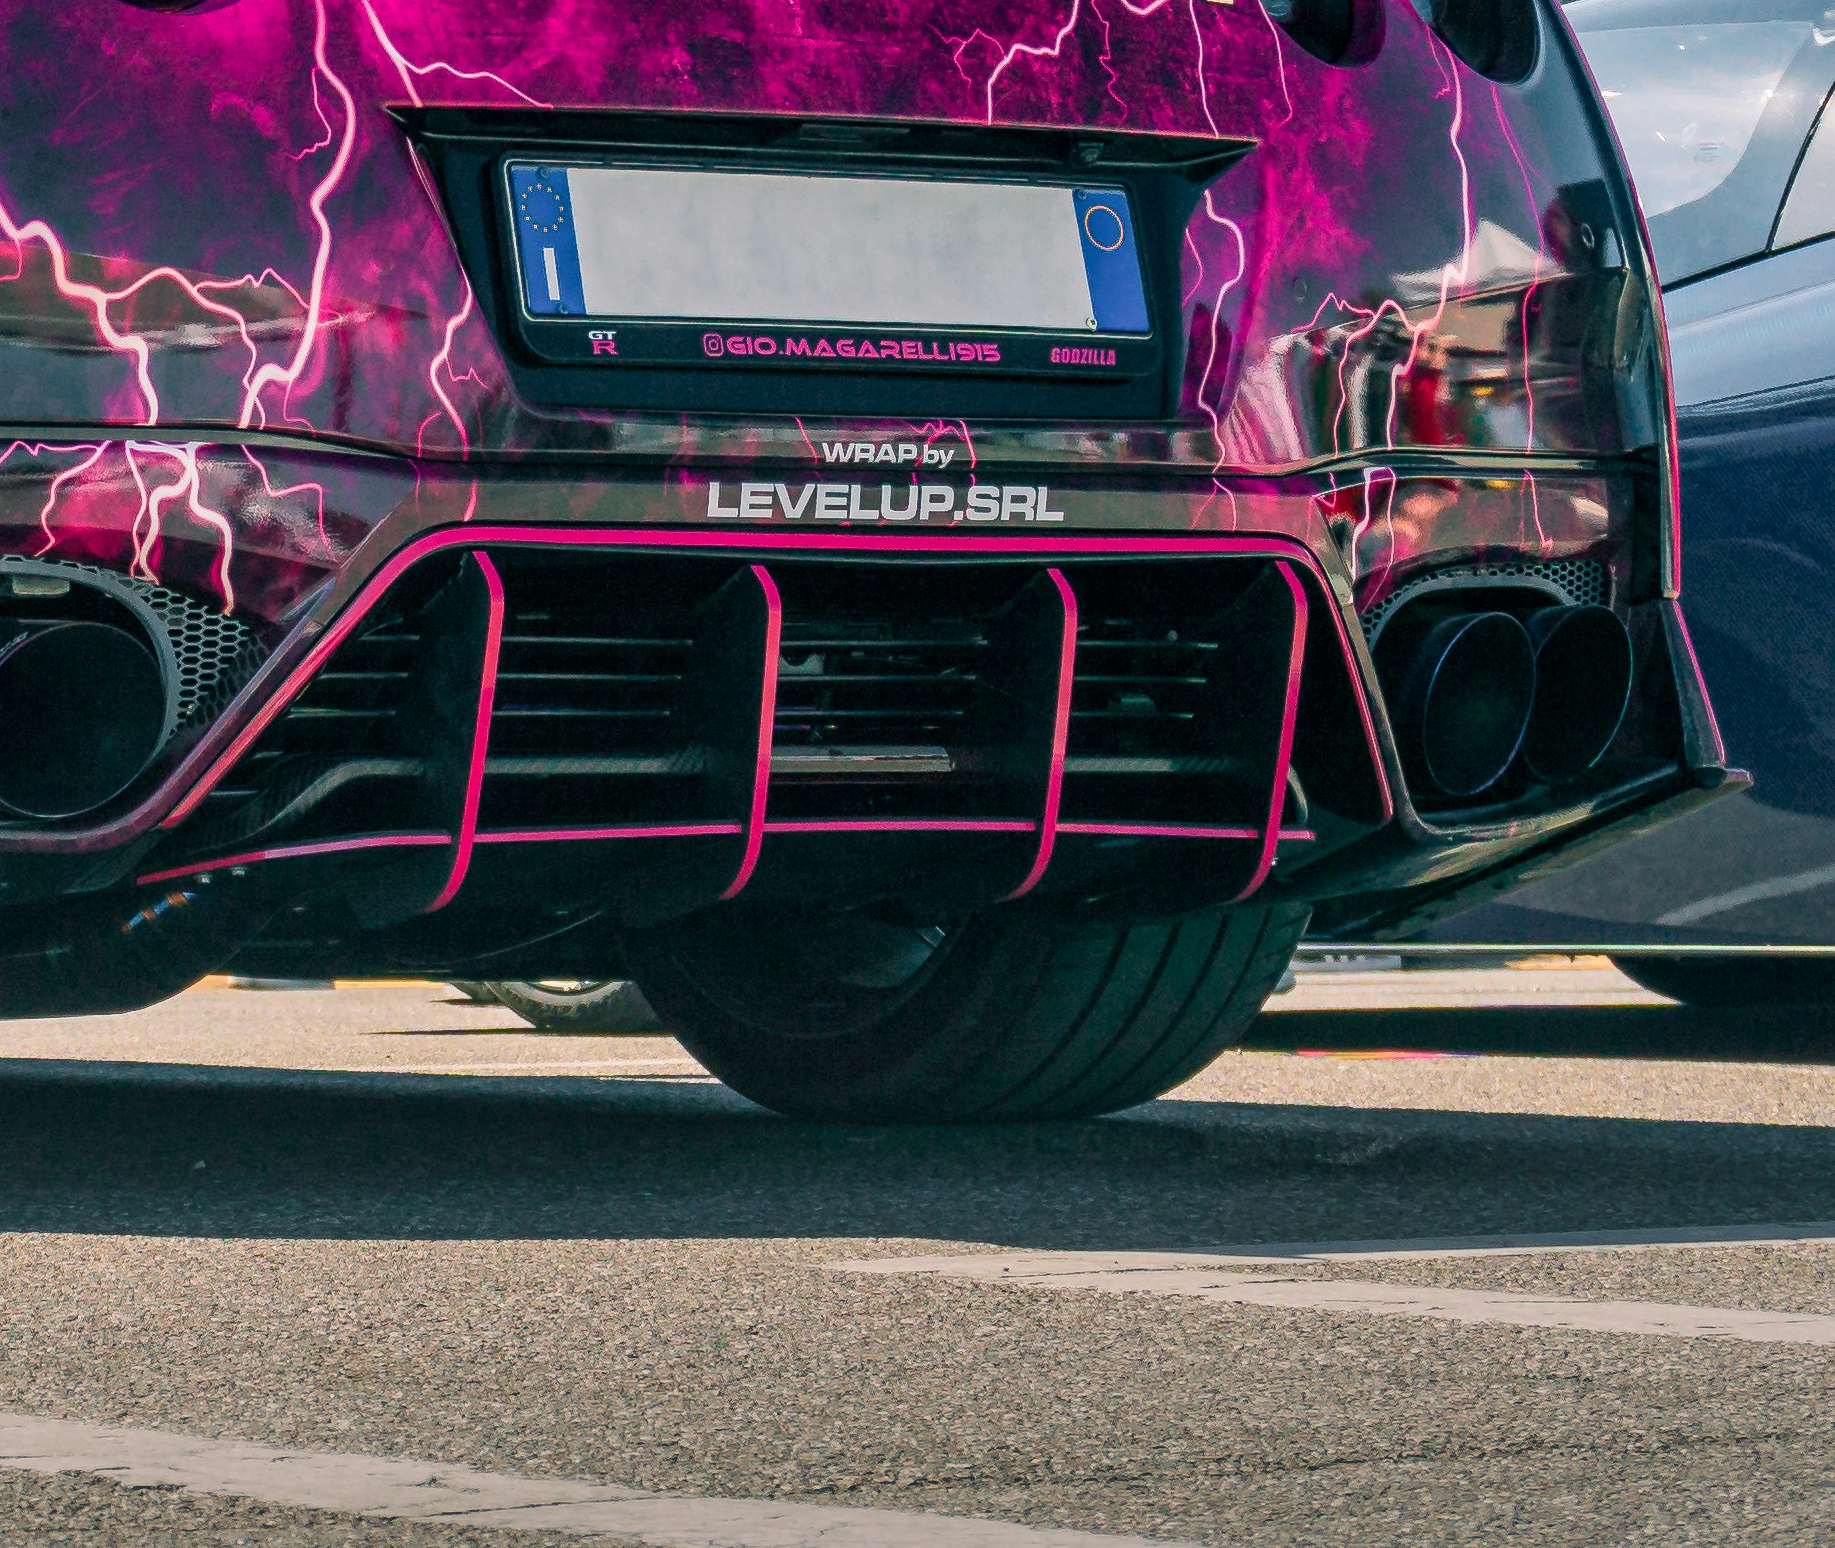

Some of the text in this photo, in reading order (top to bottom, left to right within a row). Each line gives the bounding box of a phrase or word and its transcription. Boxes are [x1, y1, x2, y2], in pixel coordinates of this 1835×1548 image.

[1050, 346, 1117, 367] GODZILLA
[821, 442, 955, 469] WRAP by
[705, 481, 1065, 522] LEVELUP.SRL
